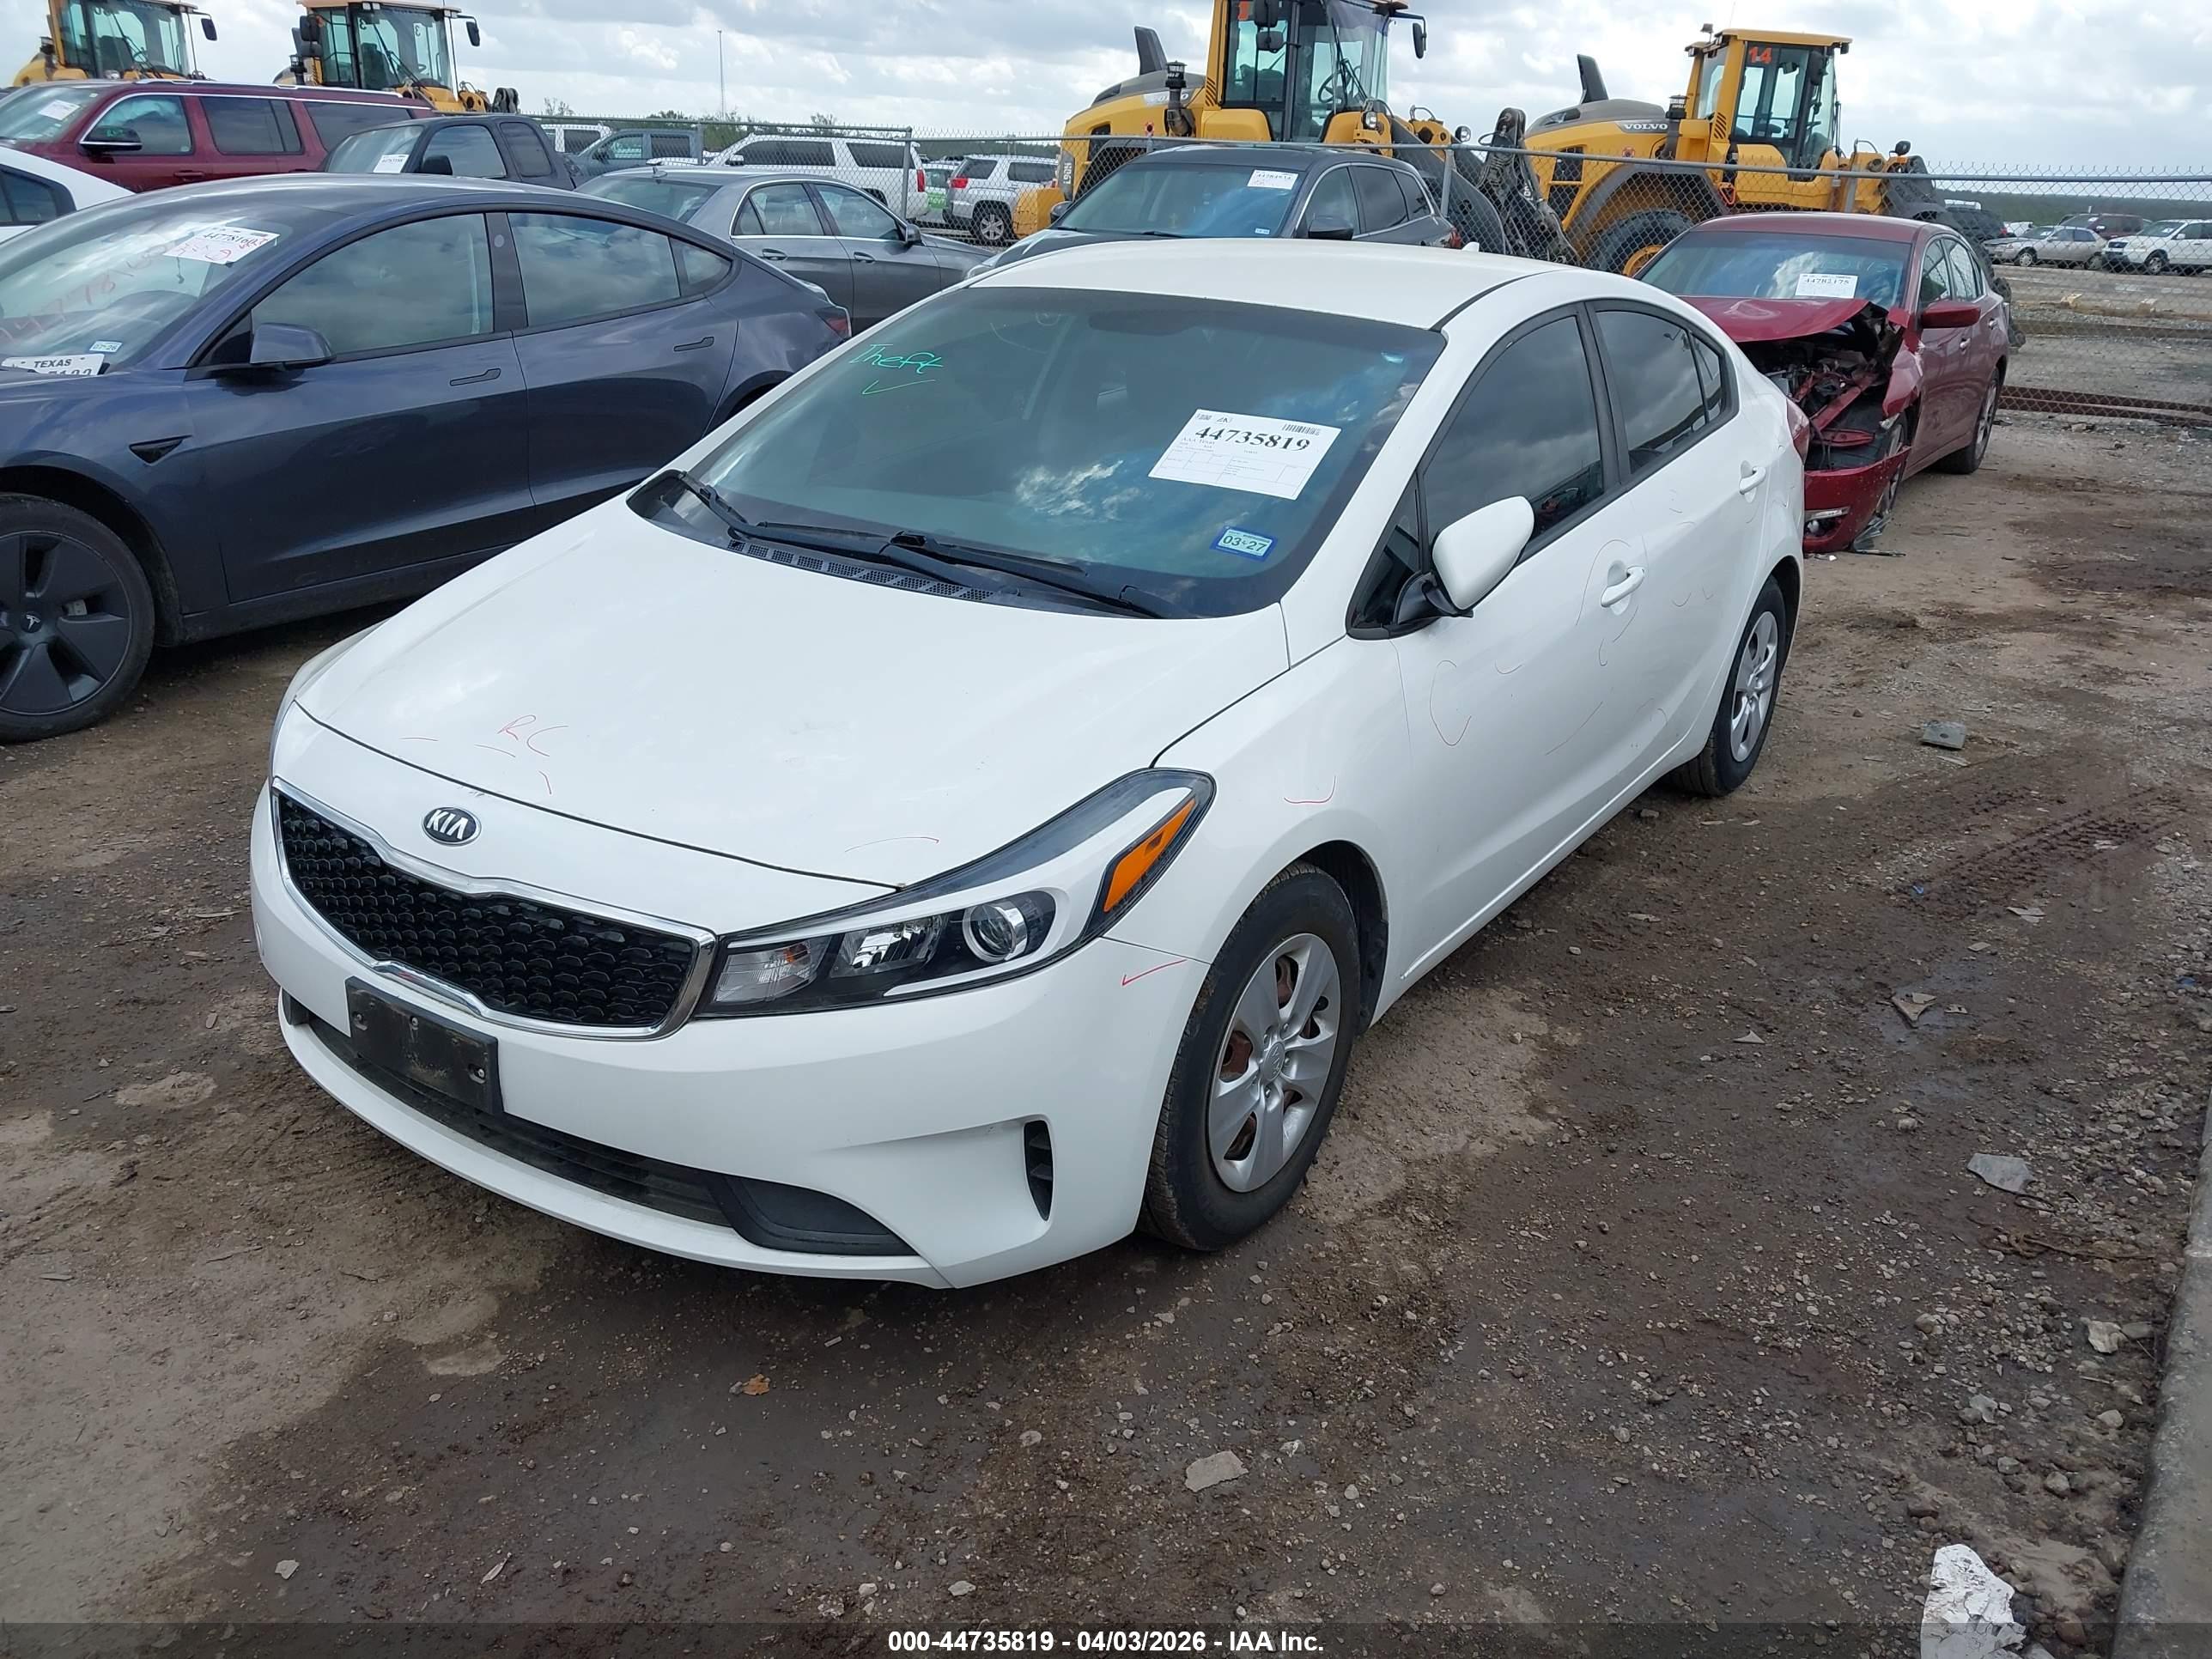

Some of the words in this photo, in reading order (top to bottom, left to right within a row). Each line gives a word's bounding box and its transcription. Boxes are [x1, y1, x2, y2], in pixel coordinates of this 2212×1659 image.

[1748, 46, 1772, 64] 14
[33, 358, 72, 368] TEXAS
[1194, 426, 1310, 452] 44735819
[426, 809, 469, 840] KIA
